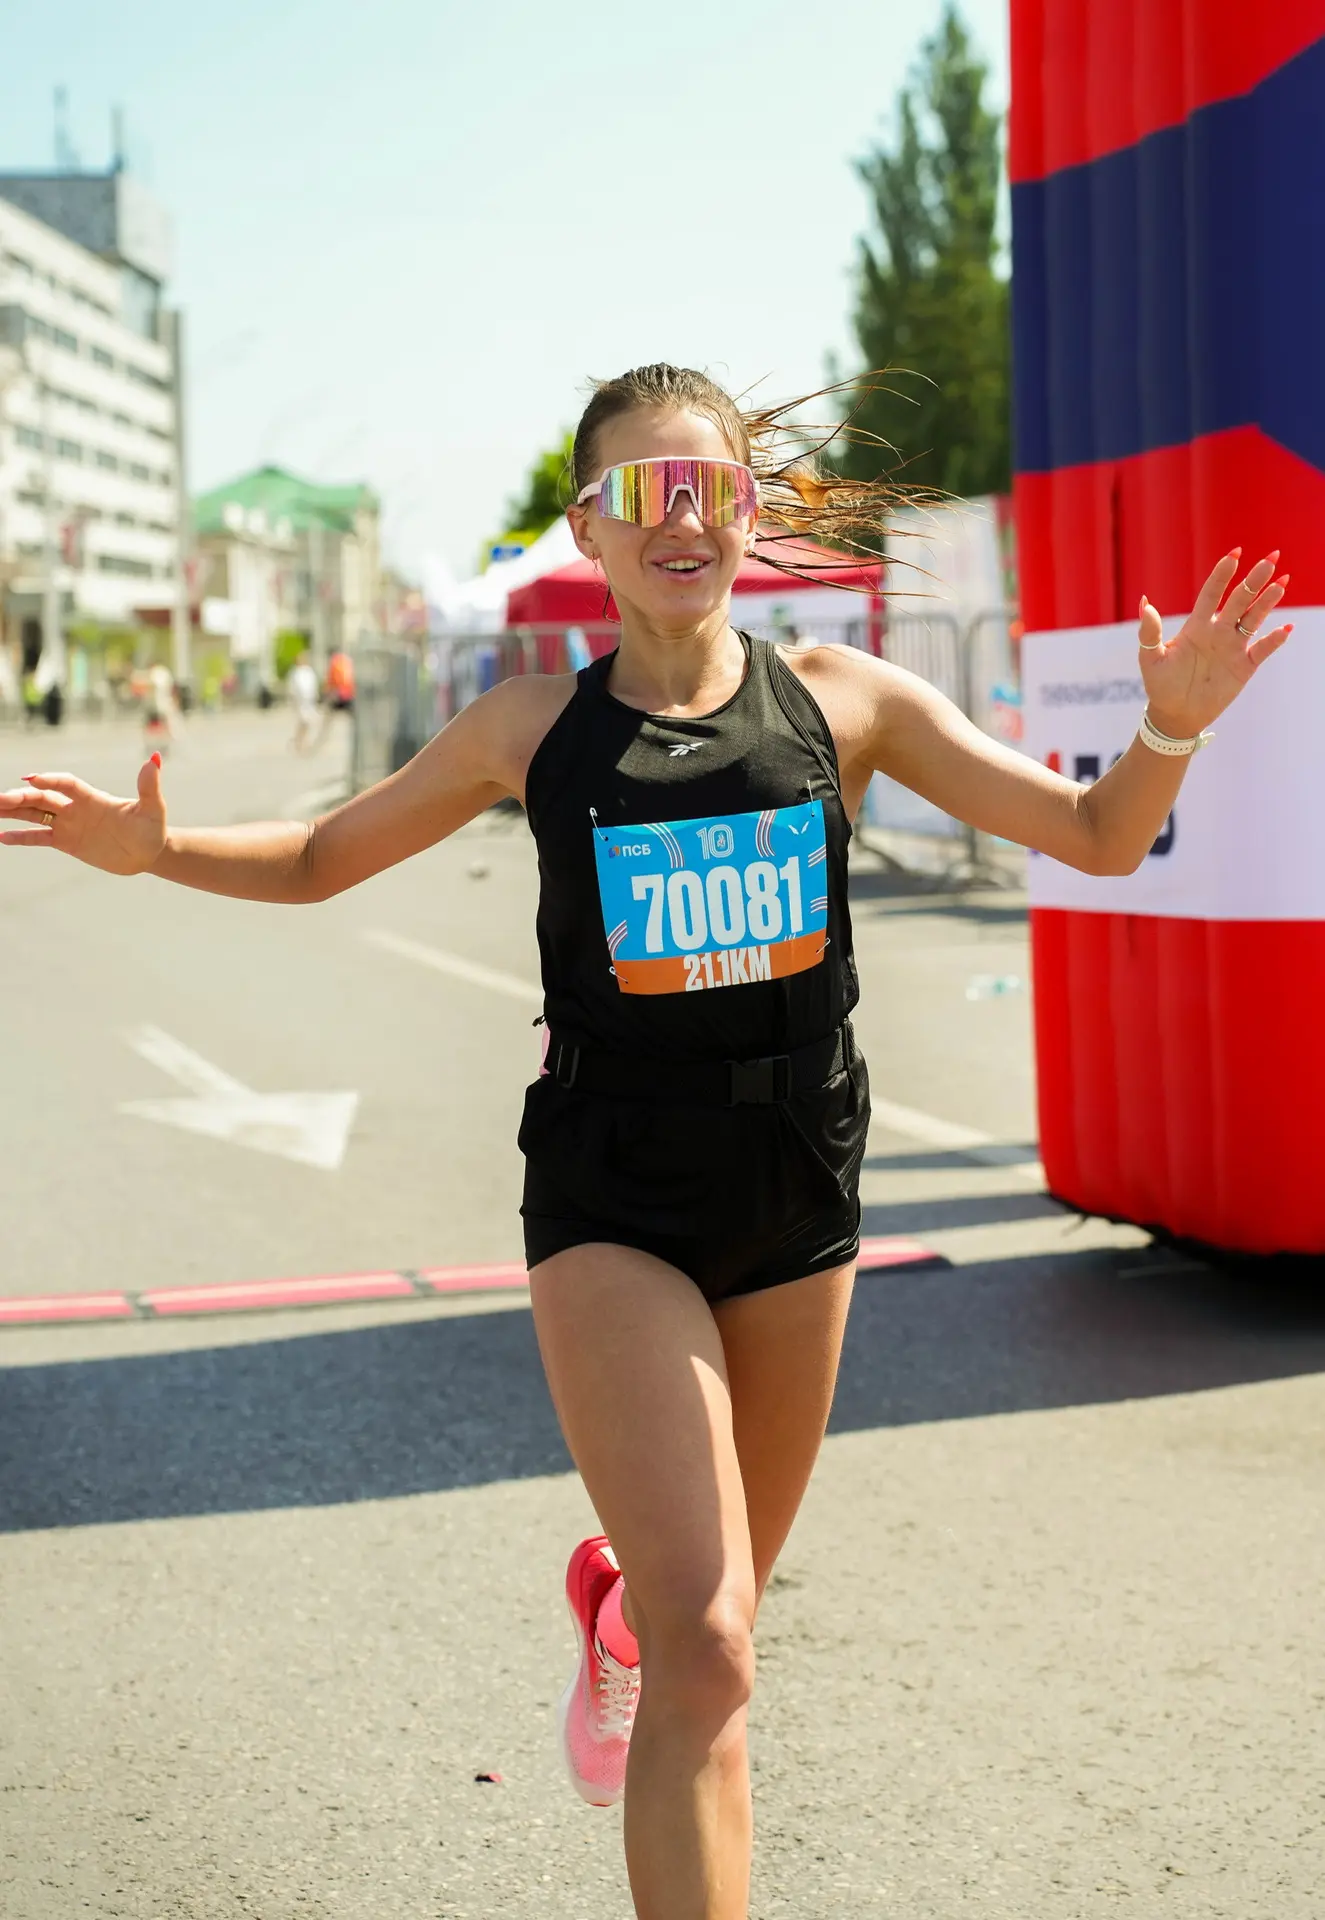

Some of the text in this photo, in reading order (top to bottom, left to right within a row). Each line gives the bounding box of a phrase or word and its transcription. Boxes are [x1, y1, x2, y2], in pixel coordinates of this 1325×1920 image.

[622, 844, 651, 857] ПСБ
[696, 824, 734, 860] 10
[631, 856, 803, 953] 70081
